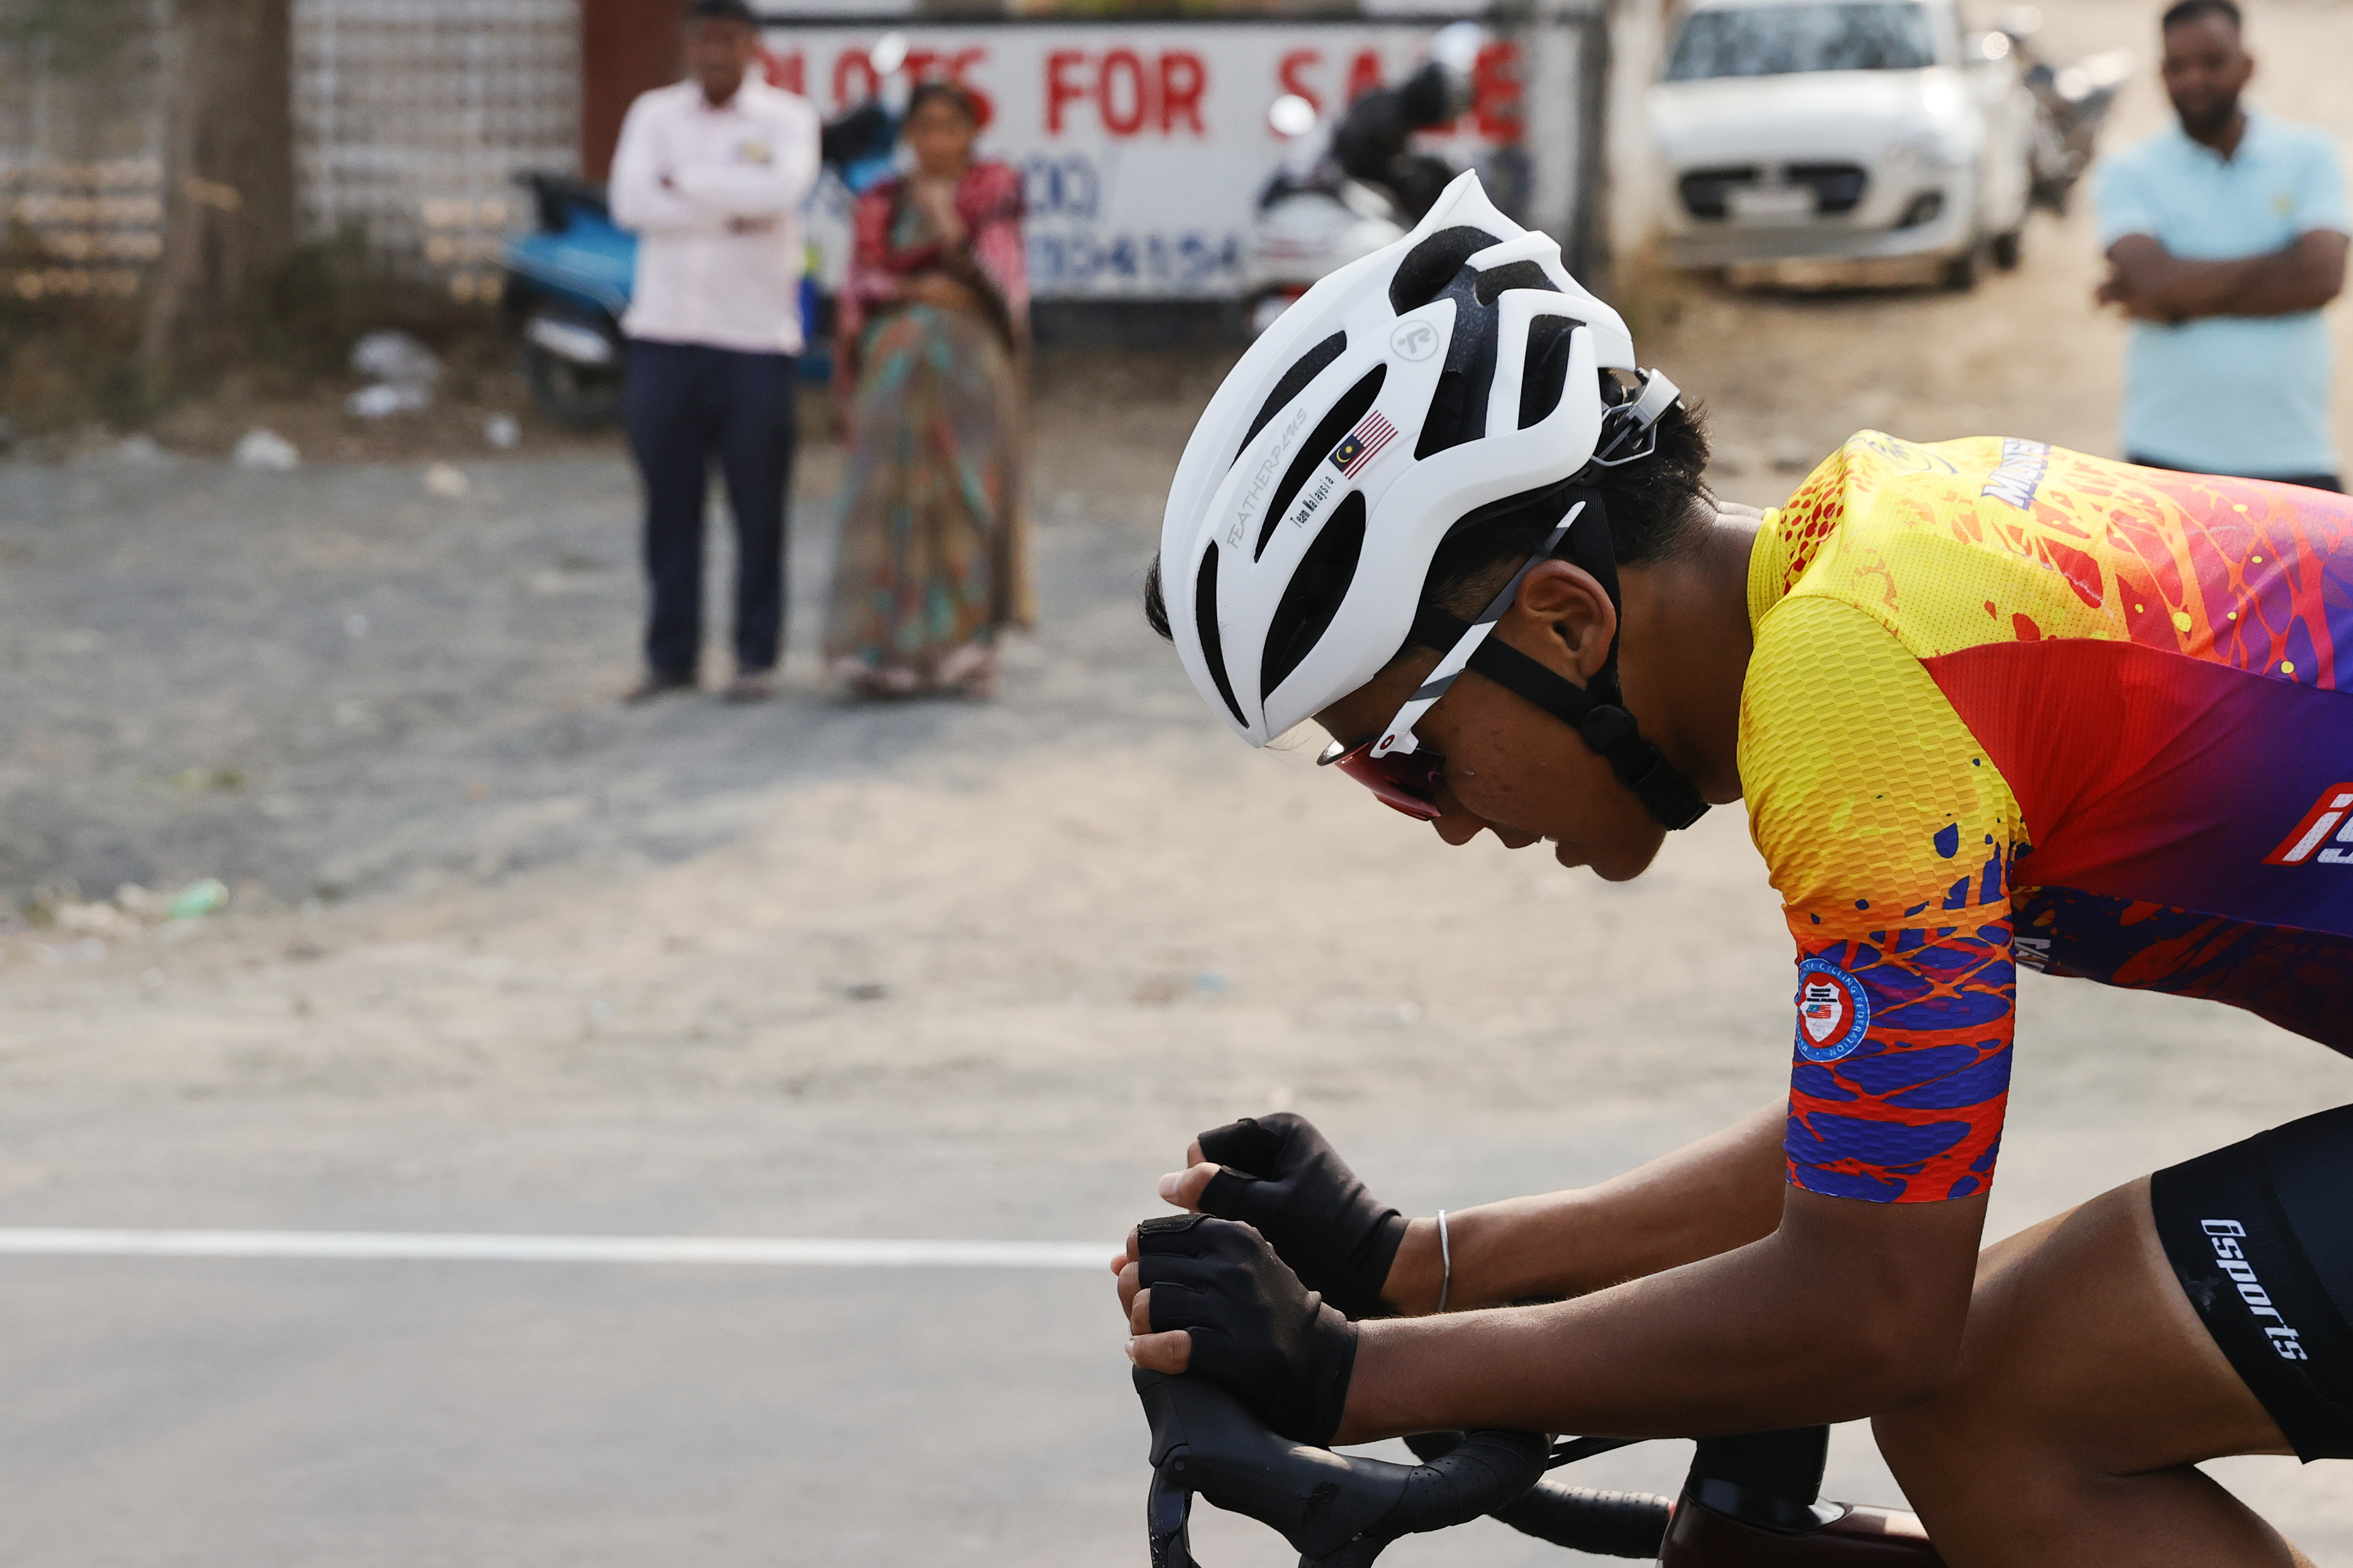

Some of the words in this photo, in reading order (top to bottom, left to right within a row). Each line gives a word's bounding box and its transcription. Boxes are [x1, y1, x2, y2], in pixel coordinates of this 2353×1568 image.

[1044, 50, 1206, 136] FOR
[1271, 43, 1525, 142] SAE
[1289, 509, 1311, 528] Team
[1302, 475, 1334, 512] Malaysia
[1819, 962, 1856, 994] CYCLING
[1830, 997, 1865, 1056] FEDERATION
